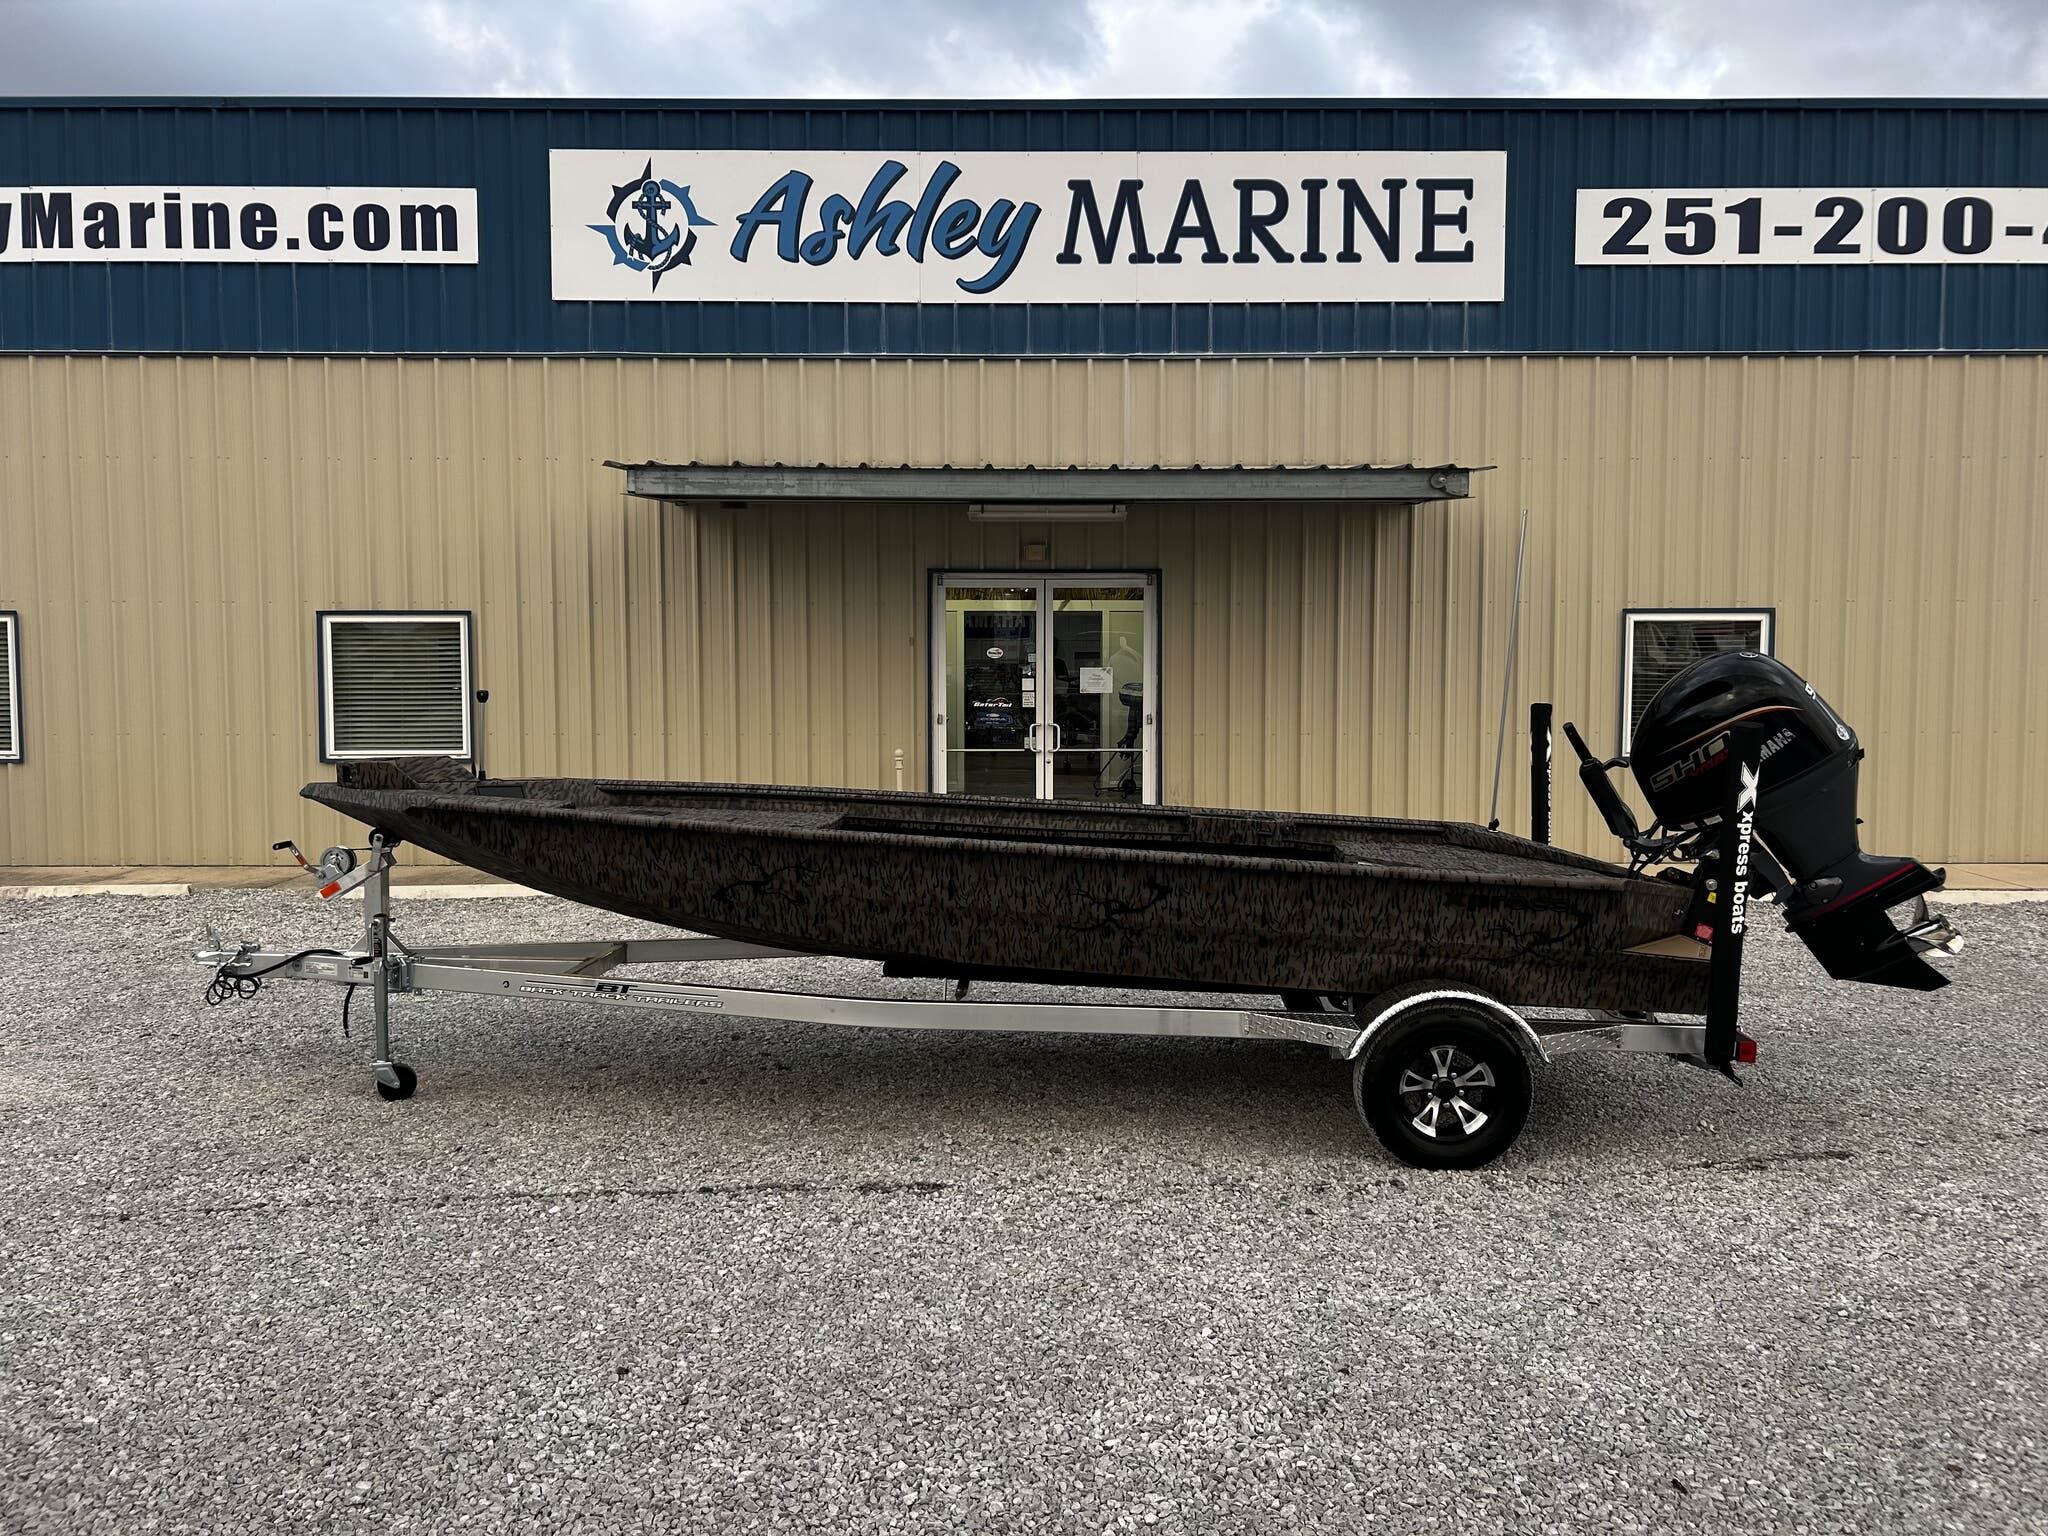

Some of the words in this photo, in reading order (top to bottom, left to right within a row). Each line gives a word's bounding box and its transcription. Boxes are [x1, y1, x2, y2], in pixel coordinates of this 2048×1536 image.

[730, 160, 1042, 294] Ashley
[1056, 178, 1475, 265] MARINE
[1602, 196, 2048, 256] 251-200-
[1759, 727, 1797, 763] MAHA
[1735, 811, 1754, 876] xpress
[1731, 881, 1749, 935] boats
[519, 985, 566, 996] BACK
[571, 989, 630, 1001] TRACK
[634, 994, 725, 1009] TRAILERS
[595, 982, 638, 994] BT
